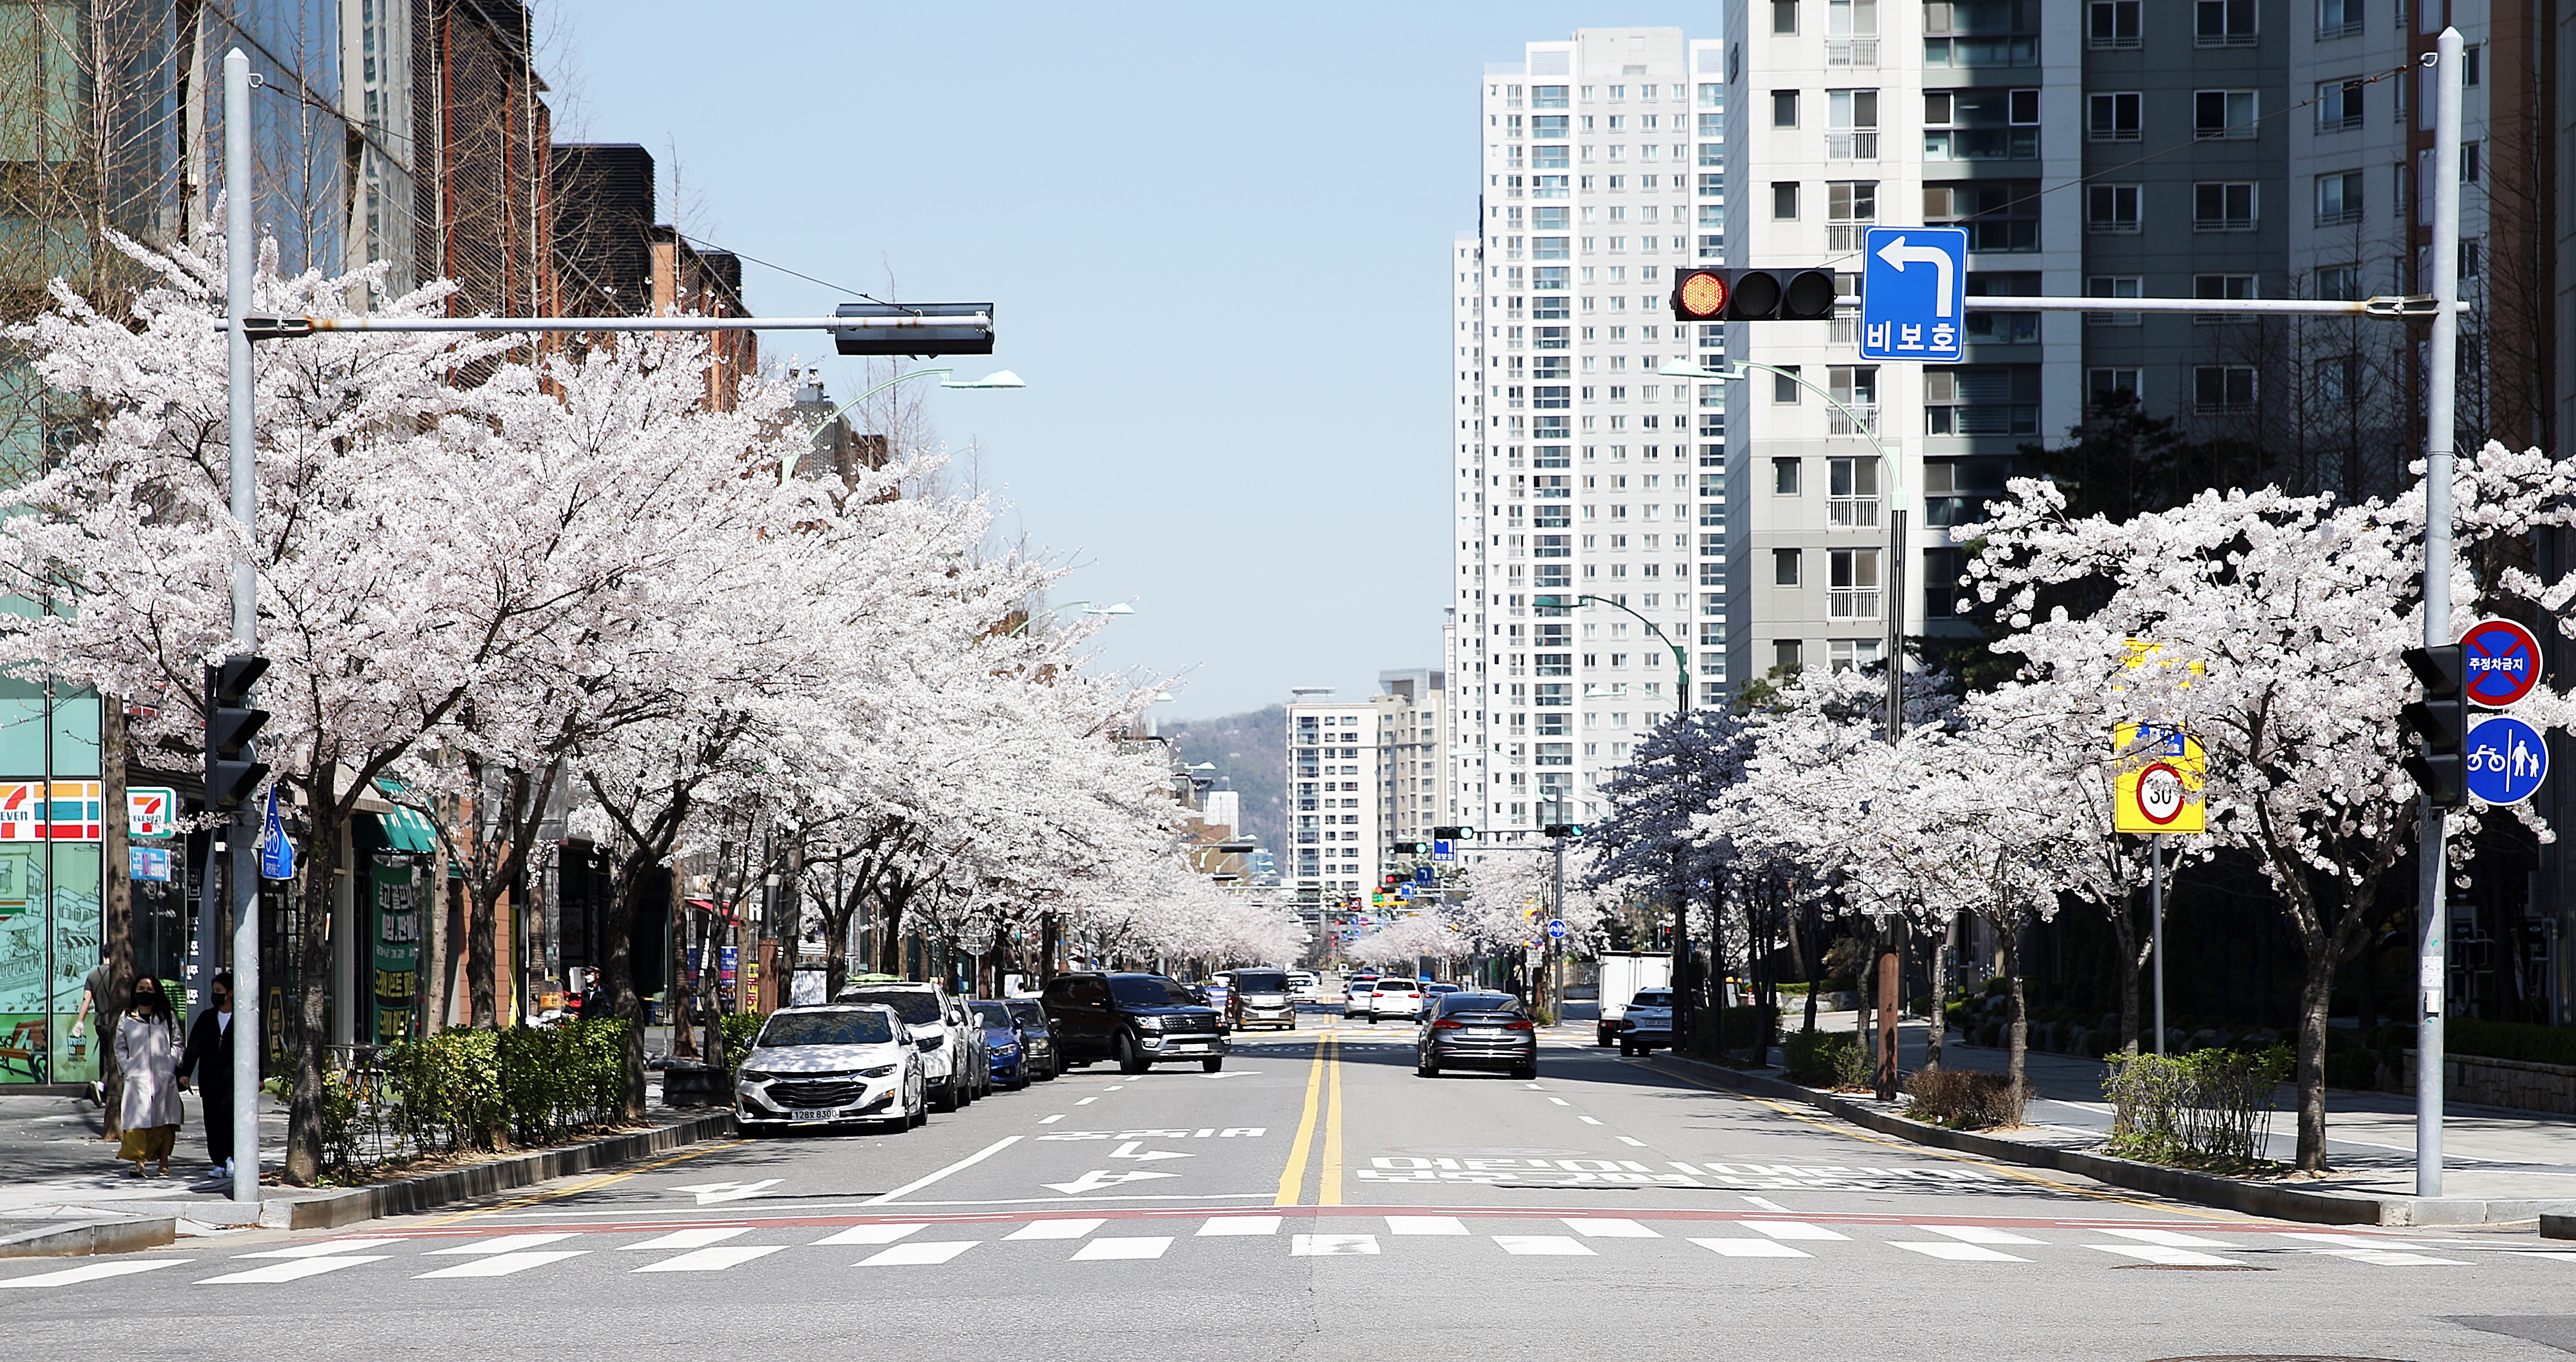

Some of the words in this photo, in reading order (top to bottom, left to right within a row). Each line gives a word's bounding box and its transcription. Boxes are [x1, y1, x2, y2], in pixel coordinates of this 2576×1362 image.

[1867, 321, 1956, 352] 비보호
[2469, 658, 2523, 670] 주정차금지
[134, 797, 161, 833] 7
[1371, 1157, 1654, 1172] 어린이
[1356, 1169, 1706, 1187] 보호구역
